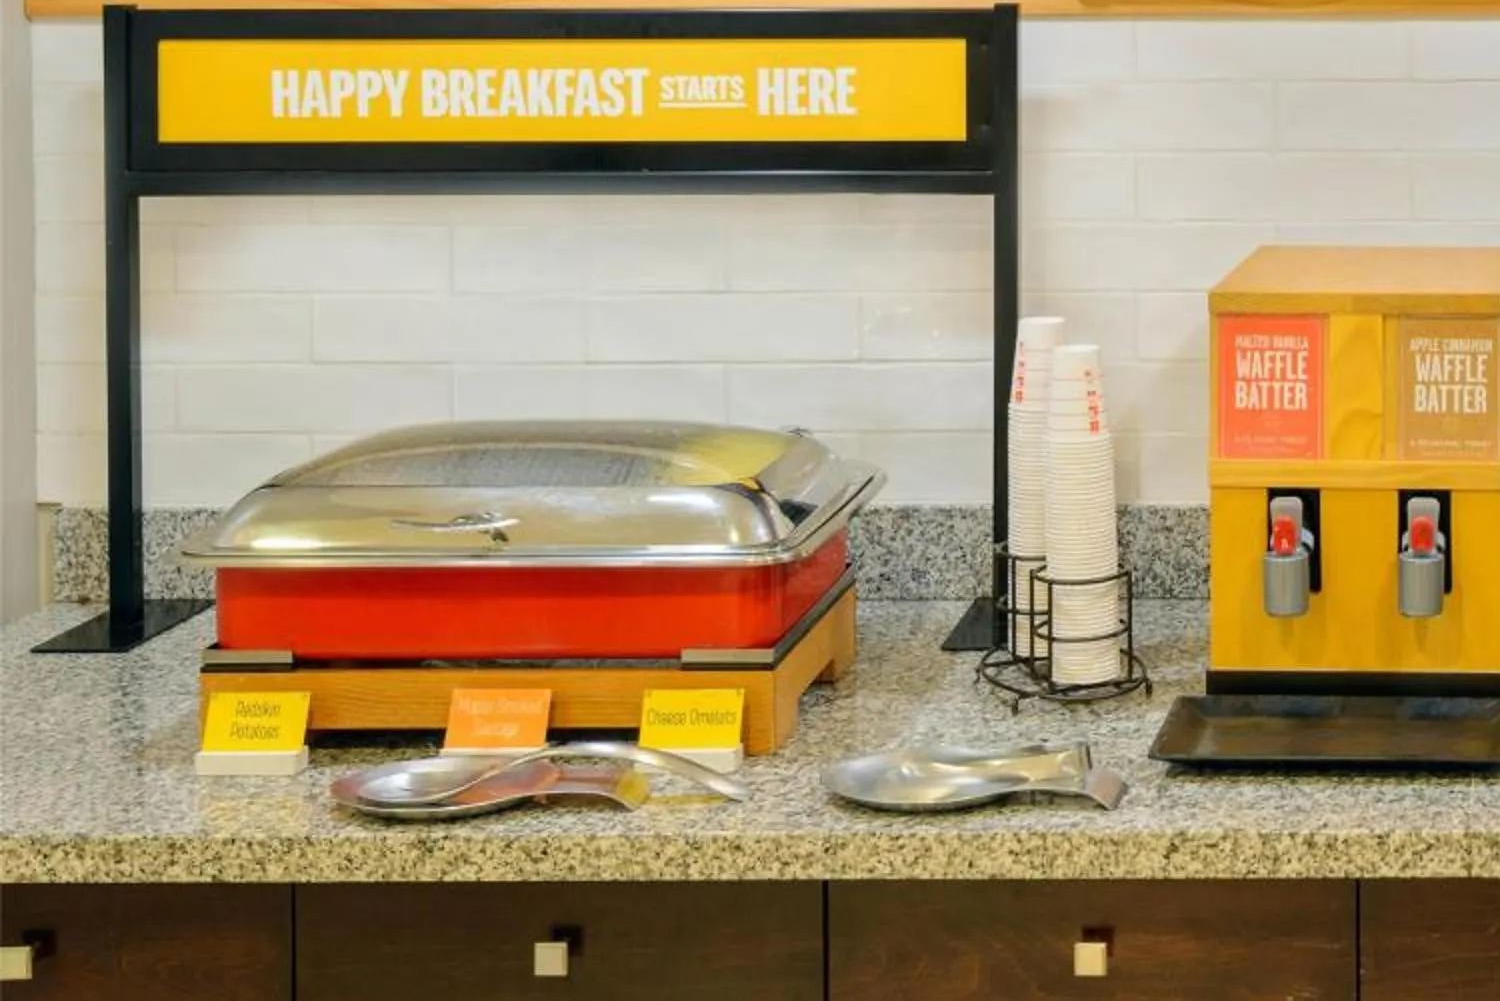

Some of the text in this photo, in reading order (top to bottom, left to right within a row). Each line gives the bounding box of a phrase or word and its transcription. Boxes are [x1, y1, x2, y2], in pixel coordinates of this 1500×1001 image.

[270, 65, 858, 119] HAPPY BREAKFAST STARTS HERE
[1235, 350, 1309, 380] WAFFLE
[1414, 353, 1488, 383] WAFFLE
[1234, 380, 1308, 411] BATTER
[1413, 384, 1487, 414] BATTER
